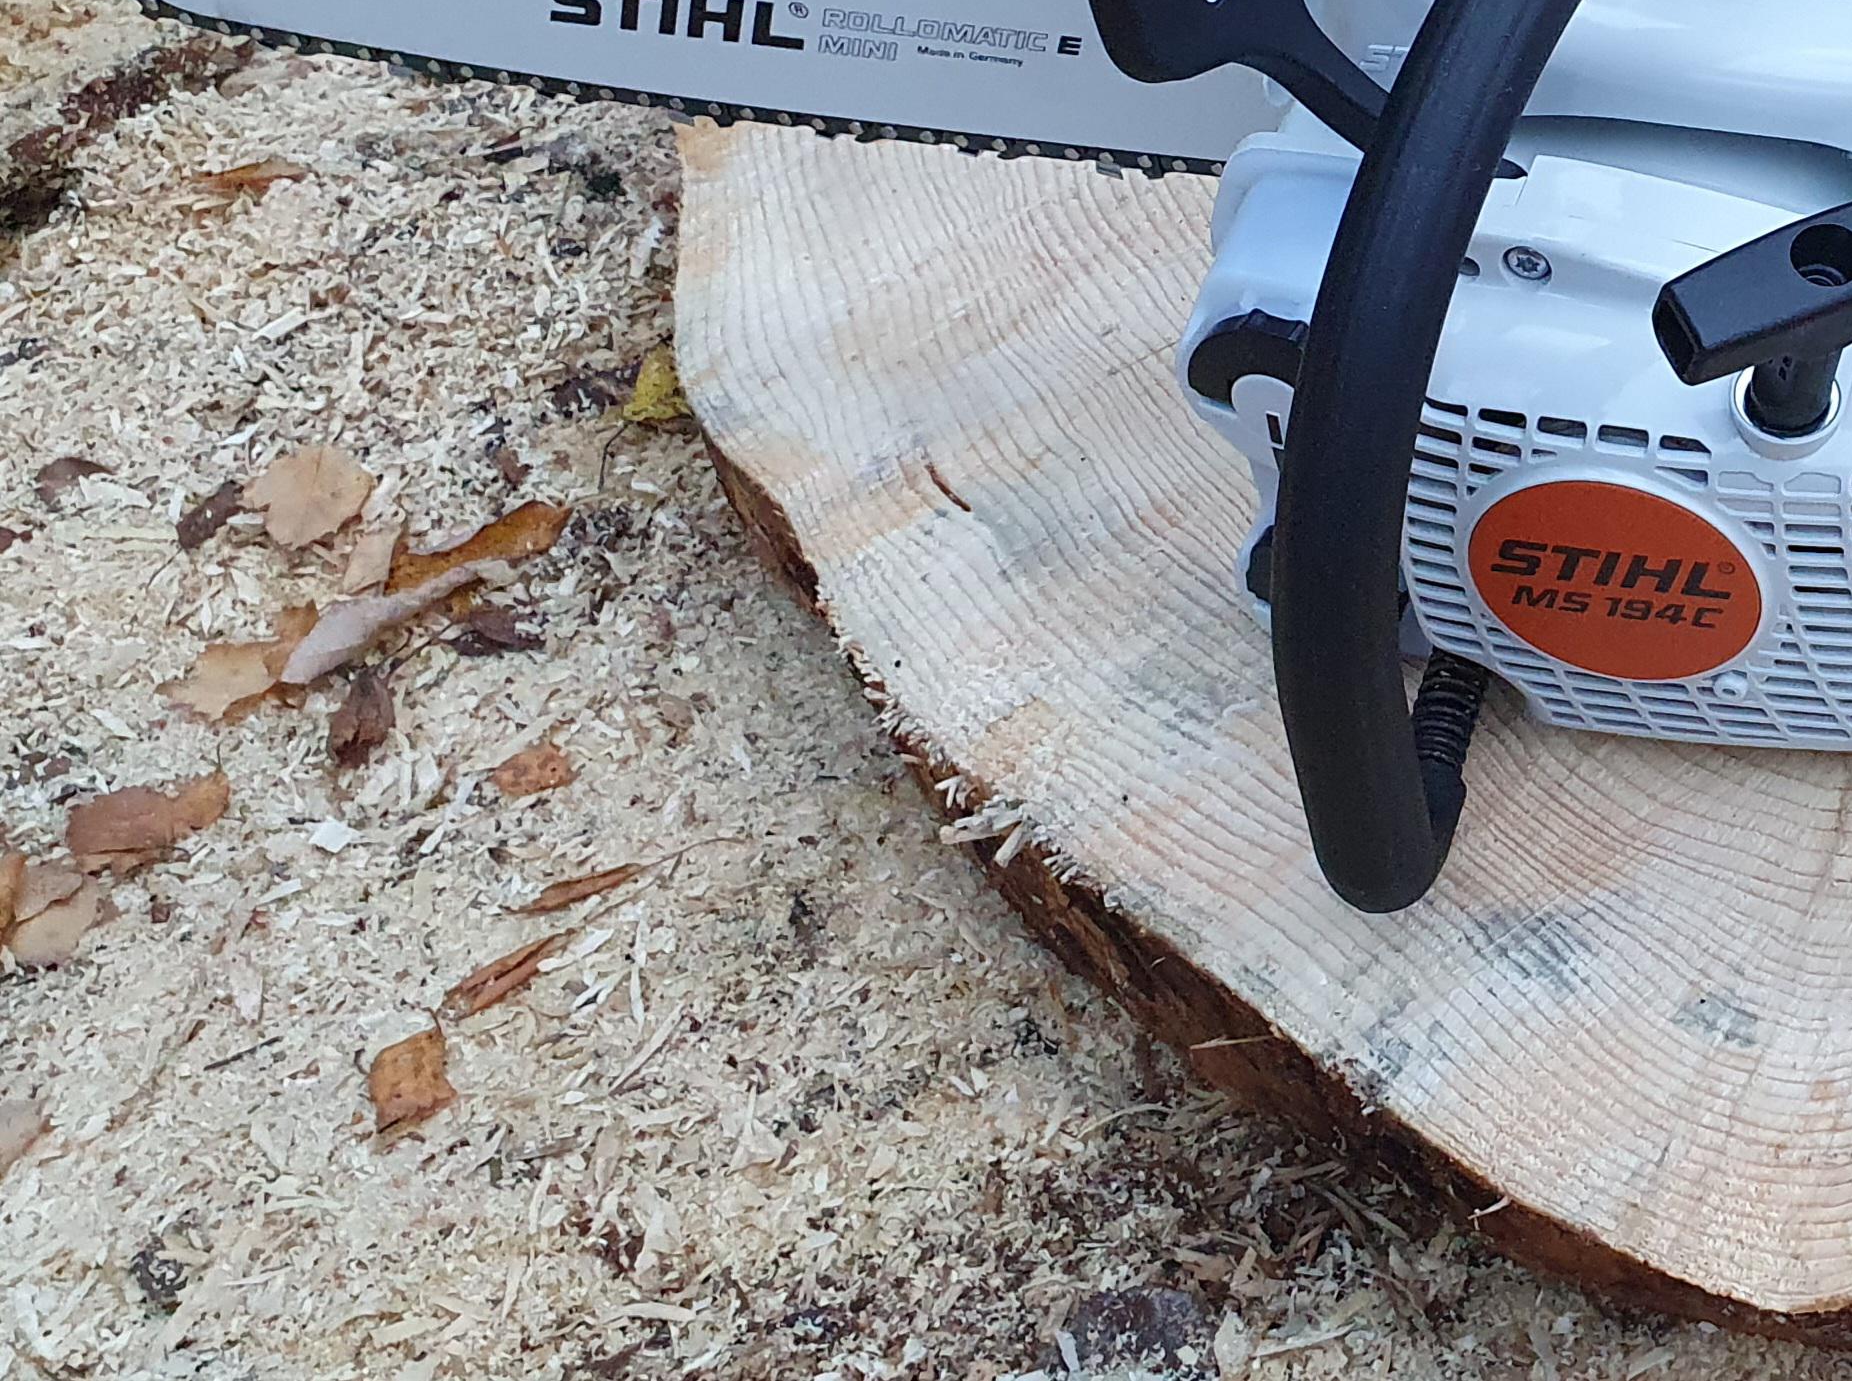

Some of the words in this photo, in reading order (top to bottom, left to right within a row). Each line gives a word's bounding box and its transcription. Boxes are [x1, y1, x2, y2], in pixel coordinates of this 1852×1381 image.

[821, 7, 1049, 52] ROLLOMATIC
[1057, 35, 1082, 56] E
[817, 34, 899, 62] MINI
[916, 45, 951, 58] Made
[968, 50, 1024, 68] Germany
[1490, 538, 1732, 600] STIHL
[1511, 585, 1593, 613] MS
